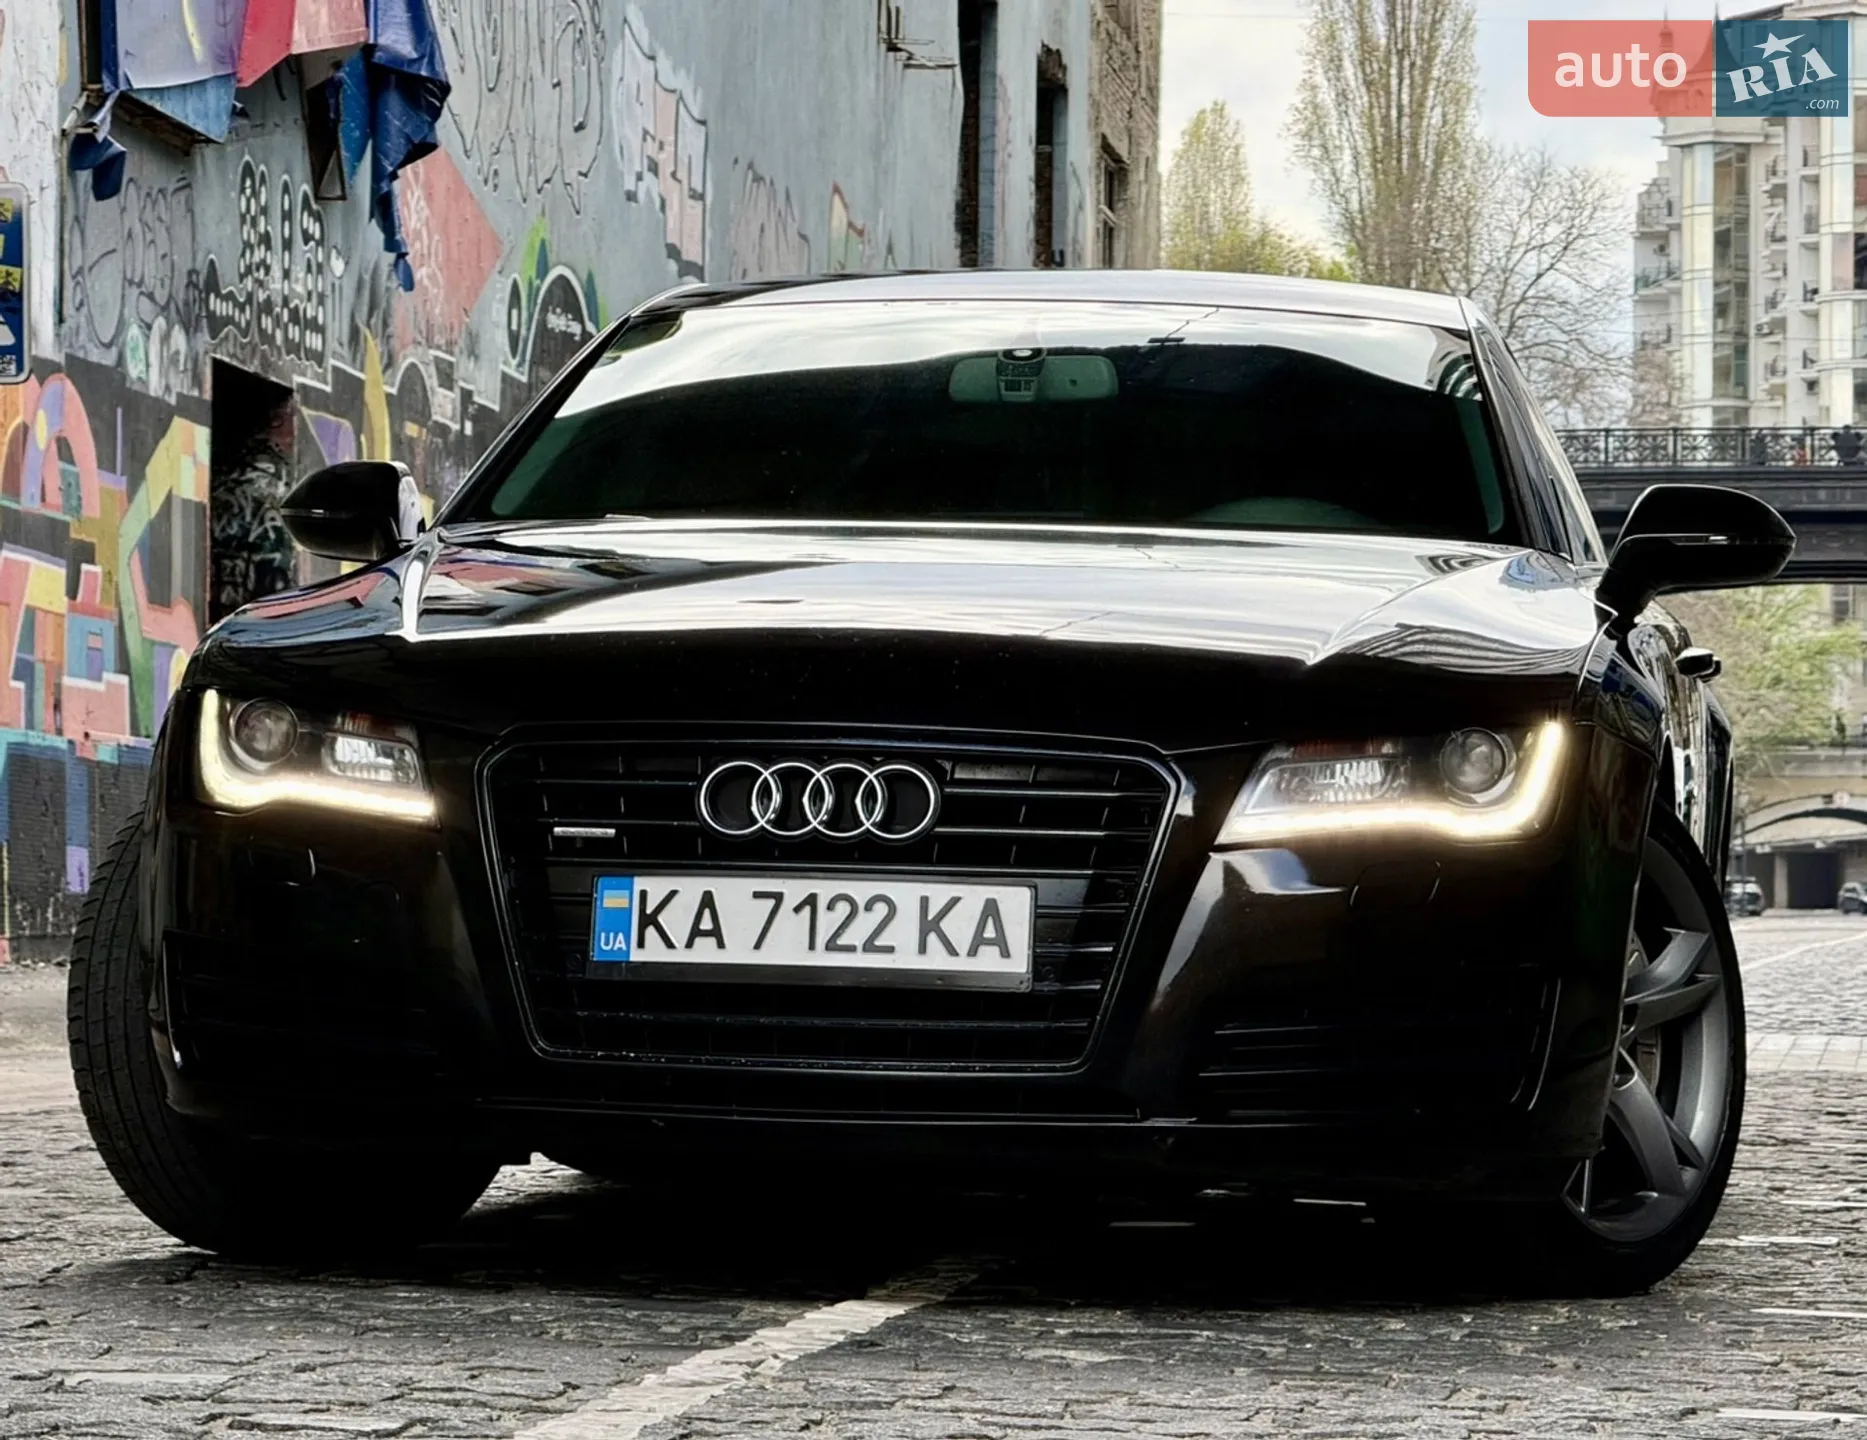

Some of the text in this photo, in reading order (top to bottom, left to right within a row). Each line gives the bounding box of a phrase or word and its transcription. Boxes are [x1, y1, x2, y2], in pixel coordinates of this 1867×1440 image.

[601, 933, 627, 951] UA
[636, 888, 1011, 957] KA 7122 KA
